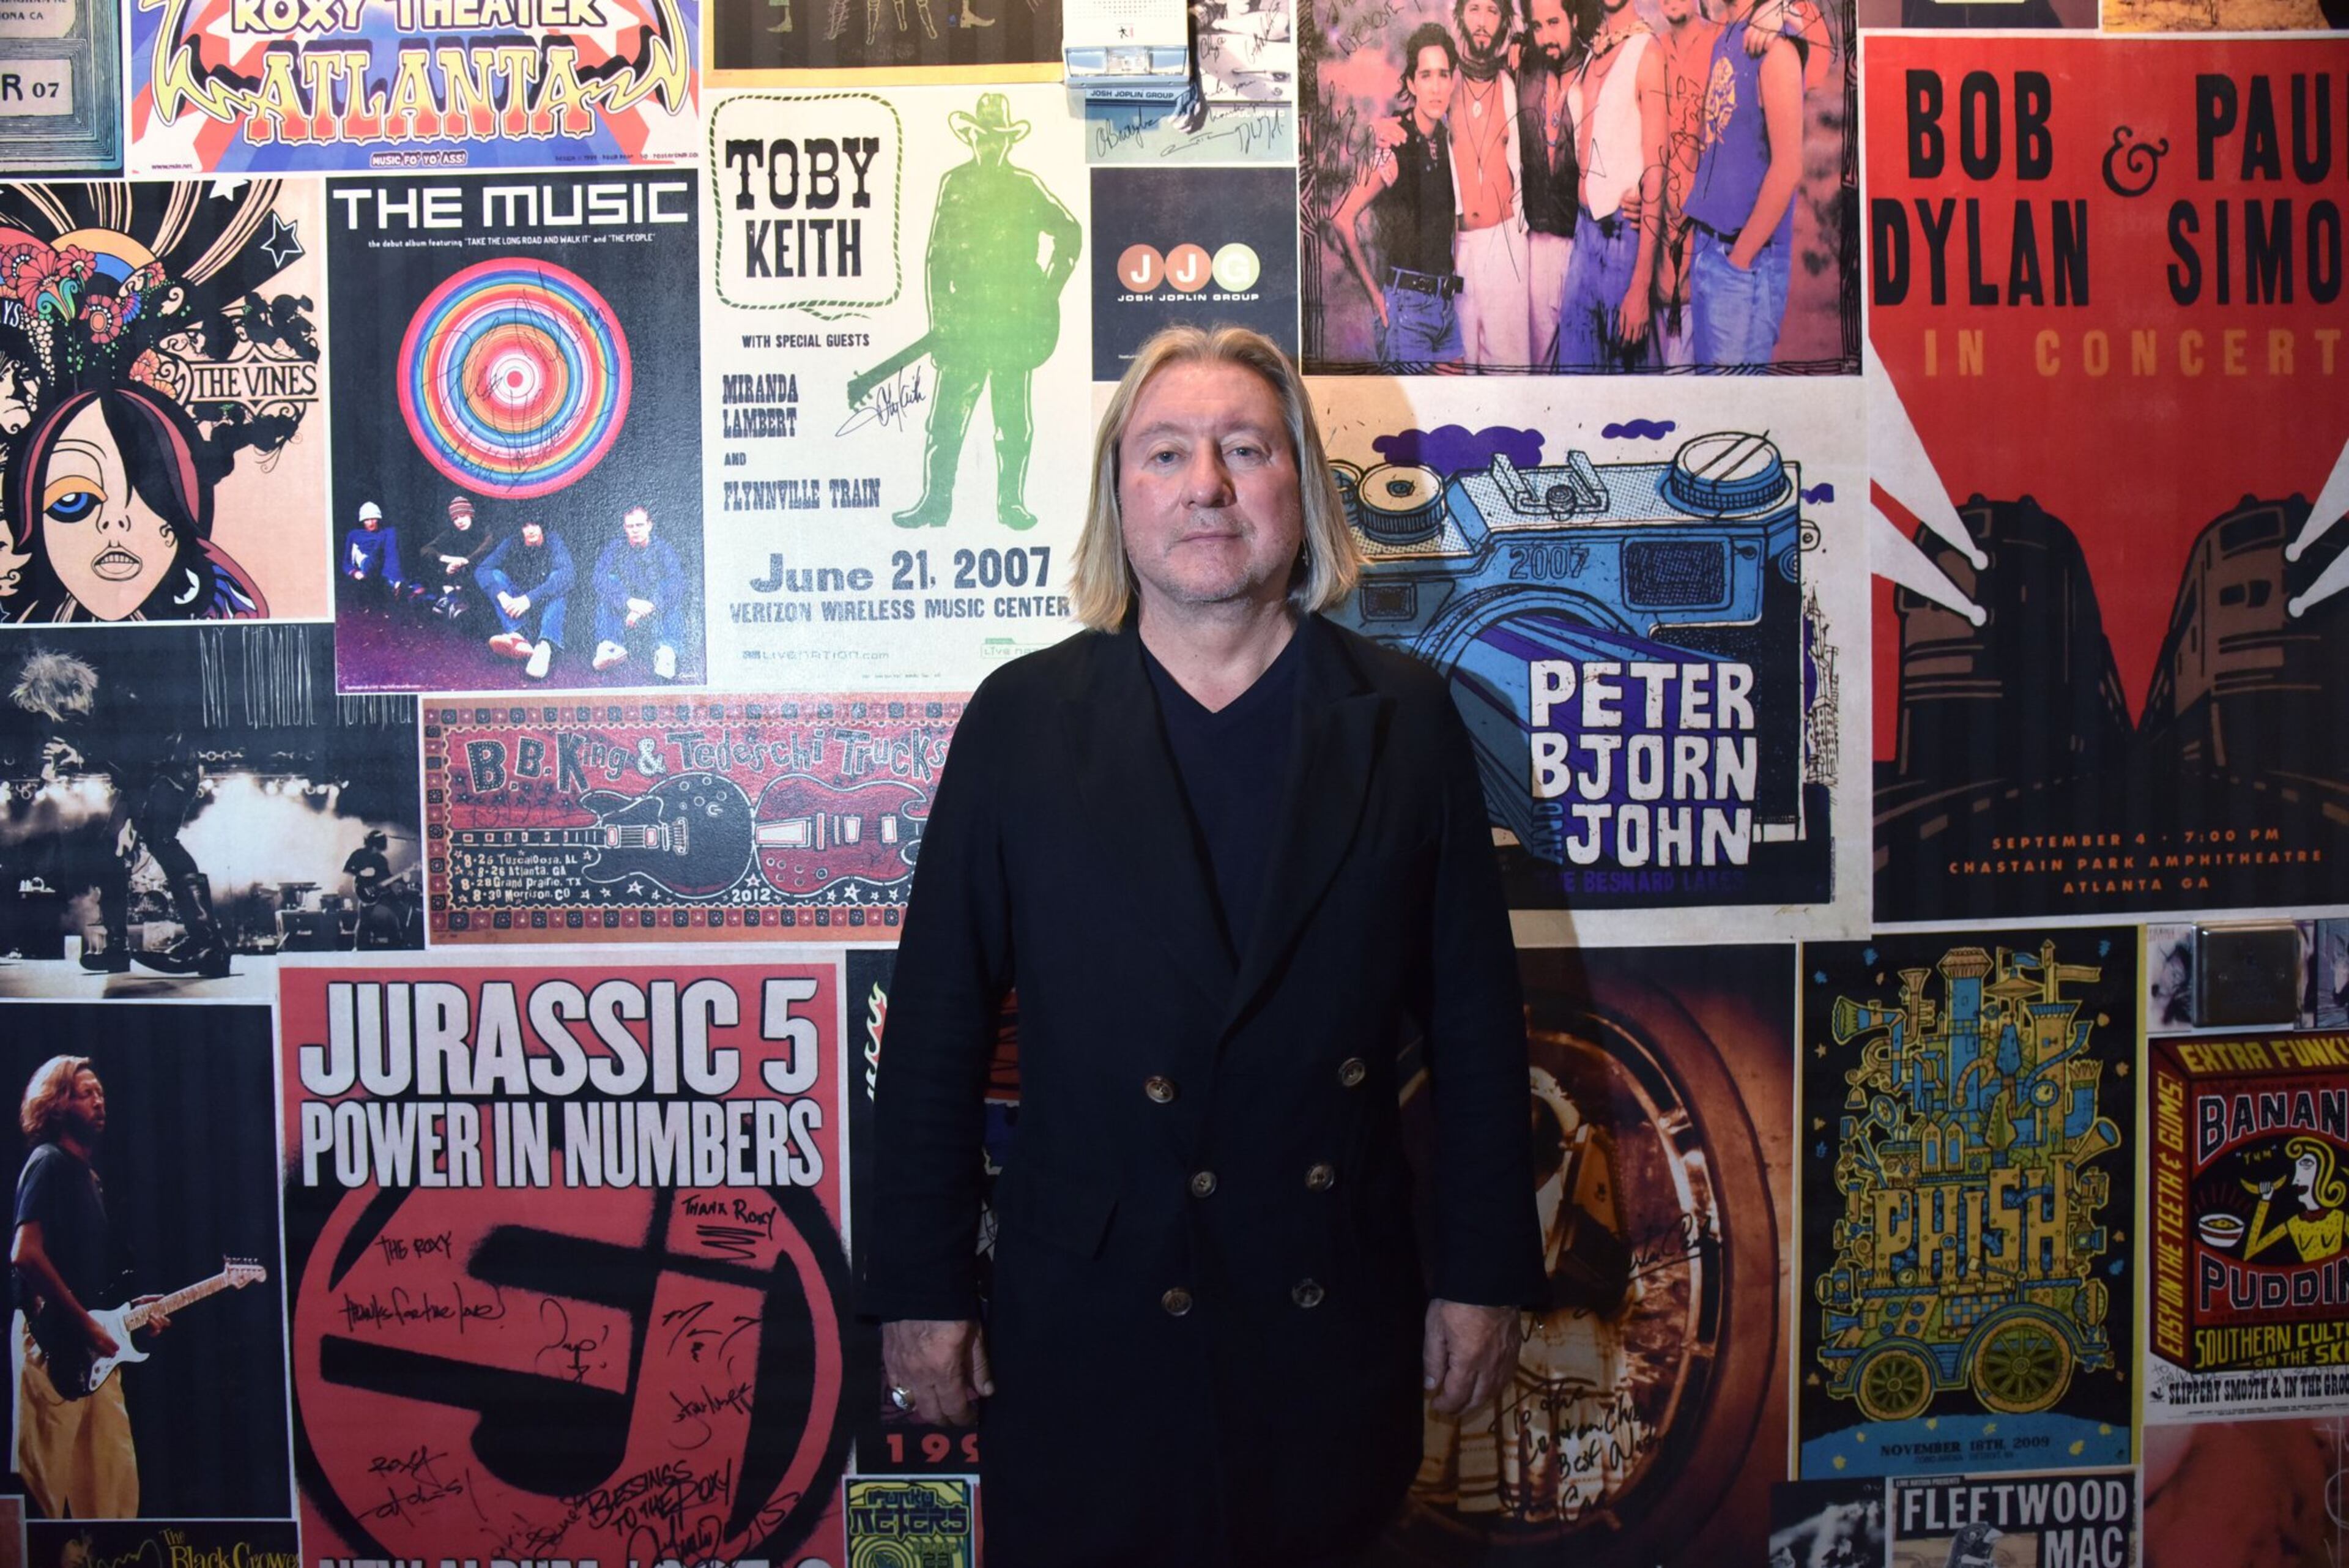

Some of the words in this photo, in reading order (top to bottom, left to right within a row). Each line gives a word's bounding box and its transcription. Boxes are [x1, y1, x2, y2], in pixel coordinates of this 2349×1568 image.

[0, 12, 24, 20] ONA
[232, 0, 363, 34] ROXY
[393, 0, 608, 32] THEATER
[32, 82, 59, 98] 07
[245, 45, 598, 146] ATLANTA
[1906, 69, 2053, 180] BOB
[2102, 125, 2169, 198] &
[2195, 72, 2349, 185] PAU
[371, 154, 401, 166] MUSIC
[442, 150, 468, 165] ASS!
[725, 137, 880, 210] TOBY
[333, 187, 462, 230] THE
[483, 181, 689, 227] MUSIC
[382, 239, 403, 248] debut
[404, 239, 427, 247] album
[428, 238, 463, 249] featuring
[488, 237, 501, 245] THE
[502, 237, 521, 245] LONG
[521, 236, 543, 245] ROAD
[544, 236, 559, 244] AND
[560, 235, 581, 243] WALK
[745, 219, 863, 278] KEITH
[1871, 198, 2090, 307] DYLAN
[2167, 198, 2342, 307] SIMO
[742, 335, 771, 348] WITH
[776, 334, 822, 347] SPECIAL
[826, 333, 870, 347] GUESTS
[1923, 329, 1984, 377] IN
[2035, 328, 2342, 377] CONCERT
[193, 366, 242, 398] THE
[244, 364, 318, 398] VINES
[722, 373, 799, 404] MIRANDA
[722, 407, 797, 438] LAMBERT
[724, 452, 747, 466] AND
[724, 479, 820, 511] FLYNNVILLE
[828, 478, 881, 508] TRAIN
[749, 552, 874, 593] June
[954, 546, 1051, 589] 2007
[1508, 546, 1589, 582] 2007
[729, 601, 812, 623] VERIZON
[820, 598, 916, 623] WIRELESS
[924, 597, 985, 619] MUSIC
[993, 595, 1072, 618] CENTER
[1530, 660, 1754, 729] PETER
[665, 727, 826, 773] Tedeschi
[833, 727, 949, 784] Trucks
[1531, 732, 1758, 801] BJORN
[1529, 801, 1564, 866] AND
[1565, 803, 1752, 868] JOHN
[1992, 834, 2121, 850] SEPTEMBER
[2184, 828, 2236, 843] 7:00
[2250, 827, 2280, 841] PM
[552, 865, 567, 876] GA
[565, 854, 578, 864] AL
[1949, 859, 2065, 875] CHASTAIN
[2078, 856, 2135, 870] PARK
[2149, 849, 2322, 869] AMPHITHEATRE
[554, 888, 571, 901] CO
[566, 877, 581, 886] TX
[731, 888, 771, 904] 2012
[1583, 870, 1675, 893] BESNARD
[2063, 877, 2162, 894] ATLANTA
[2181, 877, 2210, 890] GA
[299, 979, 740, 1097] JURASSIC
[760, 978, 820, 1096] 5
[2176, 1042, 2274, 1072] EXTRA
[2157, 1071, 2183, 1153] GUMS!
[2197, 1088, 2348, 1166] BANAN
[301, 1101, 483, 1189] POWER
[494, 1101, 551, 1189] IN
[565, 1098, 824, 1188] NUMBERS
[1869, 1154, 2069, 1287] PHISH
[2157, 1168, 2183, 1239] TEETH
[2157, 1235, 2183, 1279] THE
[2157, 1274, 2183, 1308] ON
[2199, 1250, 2349, 1312] PUDDIN
[2157, 1305, 2183, 1358] EASY
[2195, 1325, 2291, 1369] SOUTHERN
[2281, 1348, 2309, 1366] THE
[2169, 1380, 2221, 1405] SLIPPERY
[2224, 1377, 2268, 1402] SMOOTH
[2270, 1376, 2281, 1399] &
[2284, 1375, 2298, 1398] IN
[2300, 1373, 2322, 1397] THE
[1880, 1442, 1961, 1458] NOVEMBER
[2013, 1436, 2050, 1450] 2009
[1903, 1479, 2128, 1531] FLEETWOOD
[159, 1528, 186, 1547] The
[2044, 1526, 2123, 1568] MAC
[170, 1544, 229, 1568] Black
